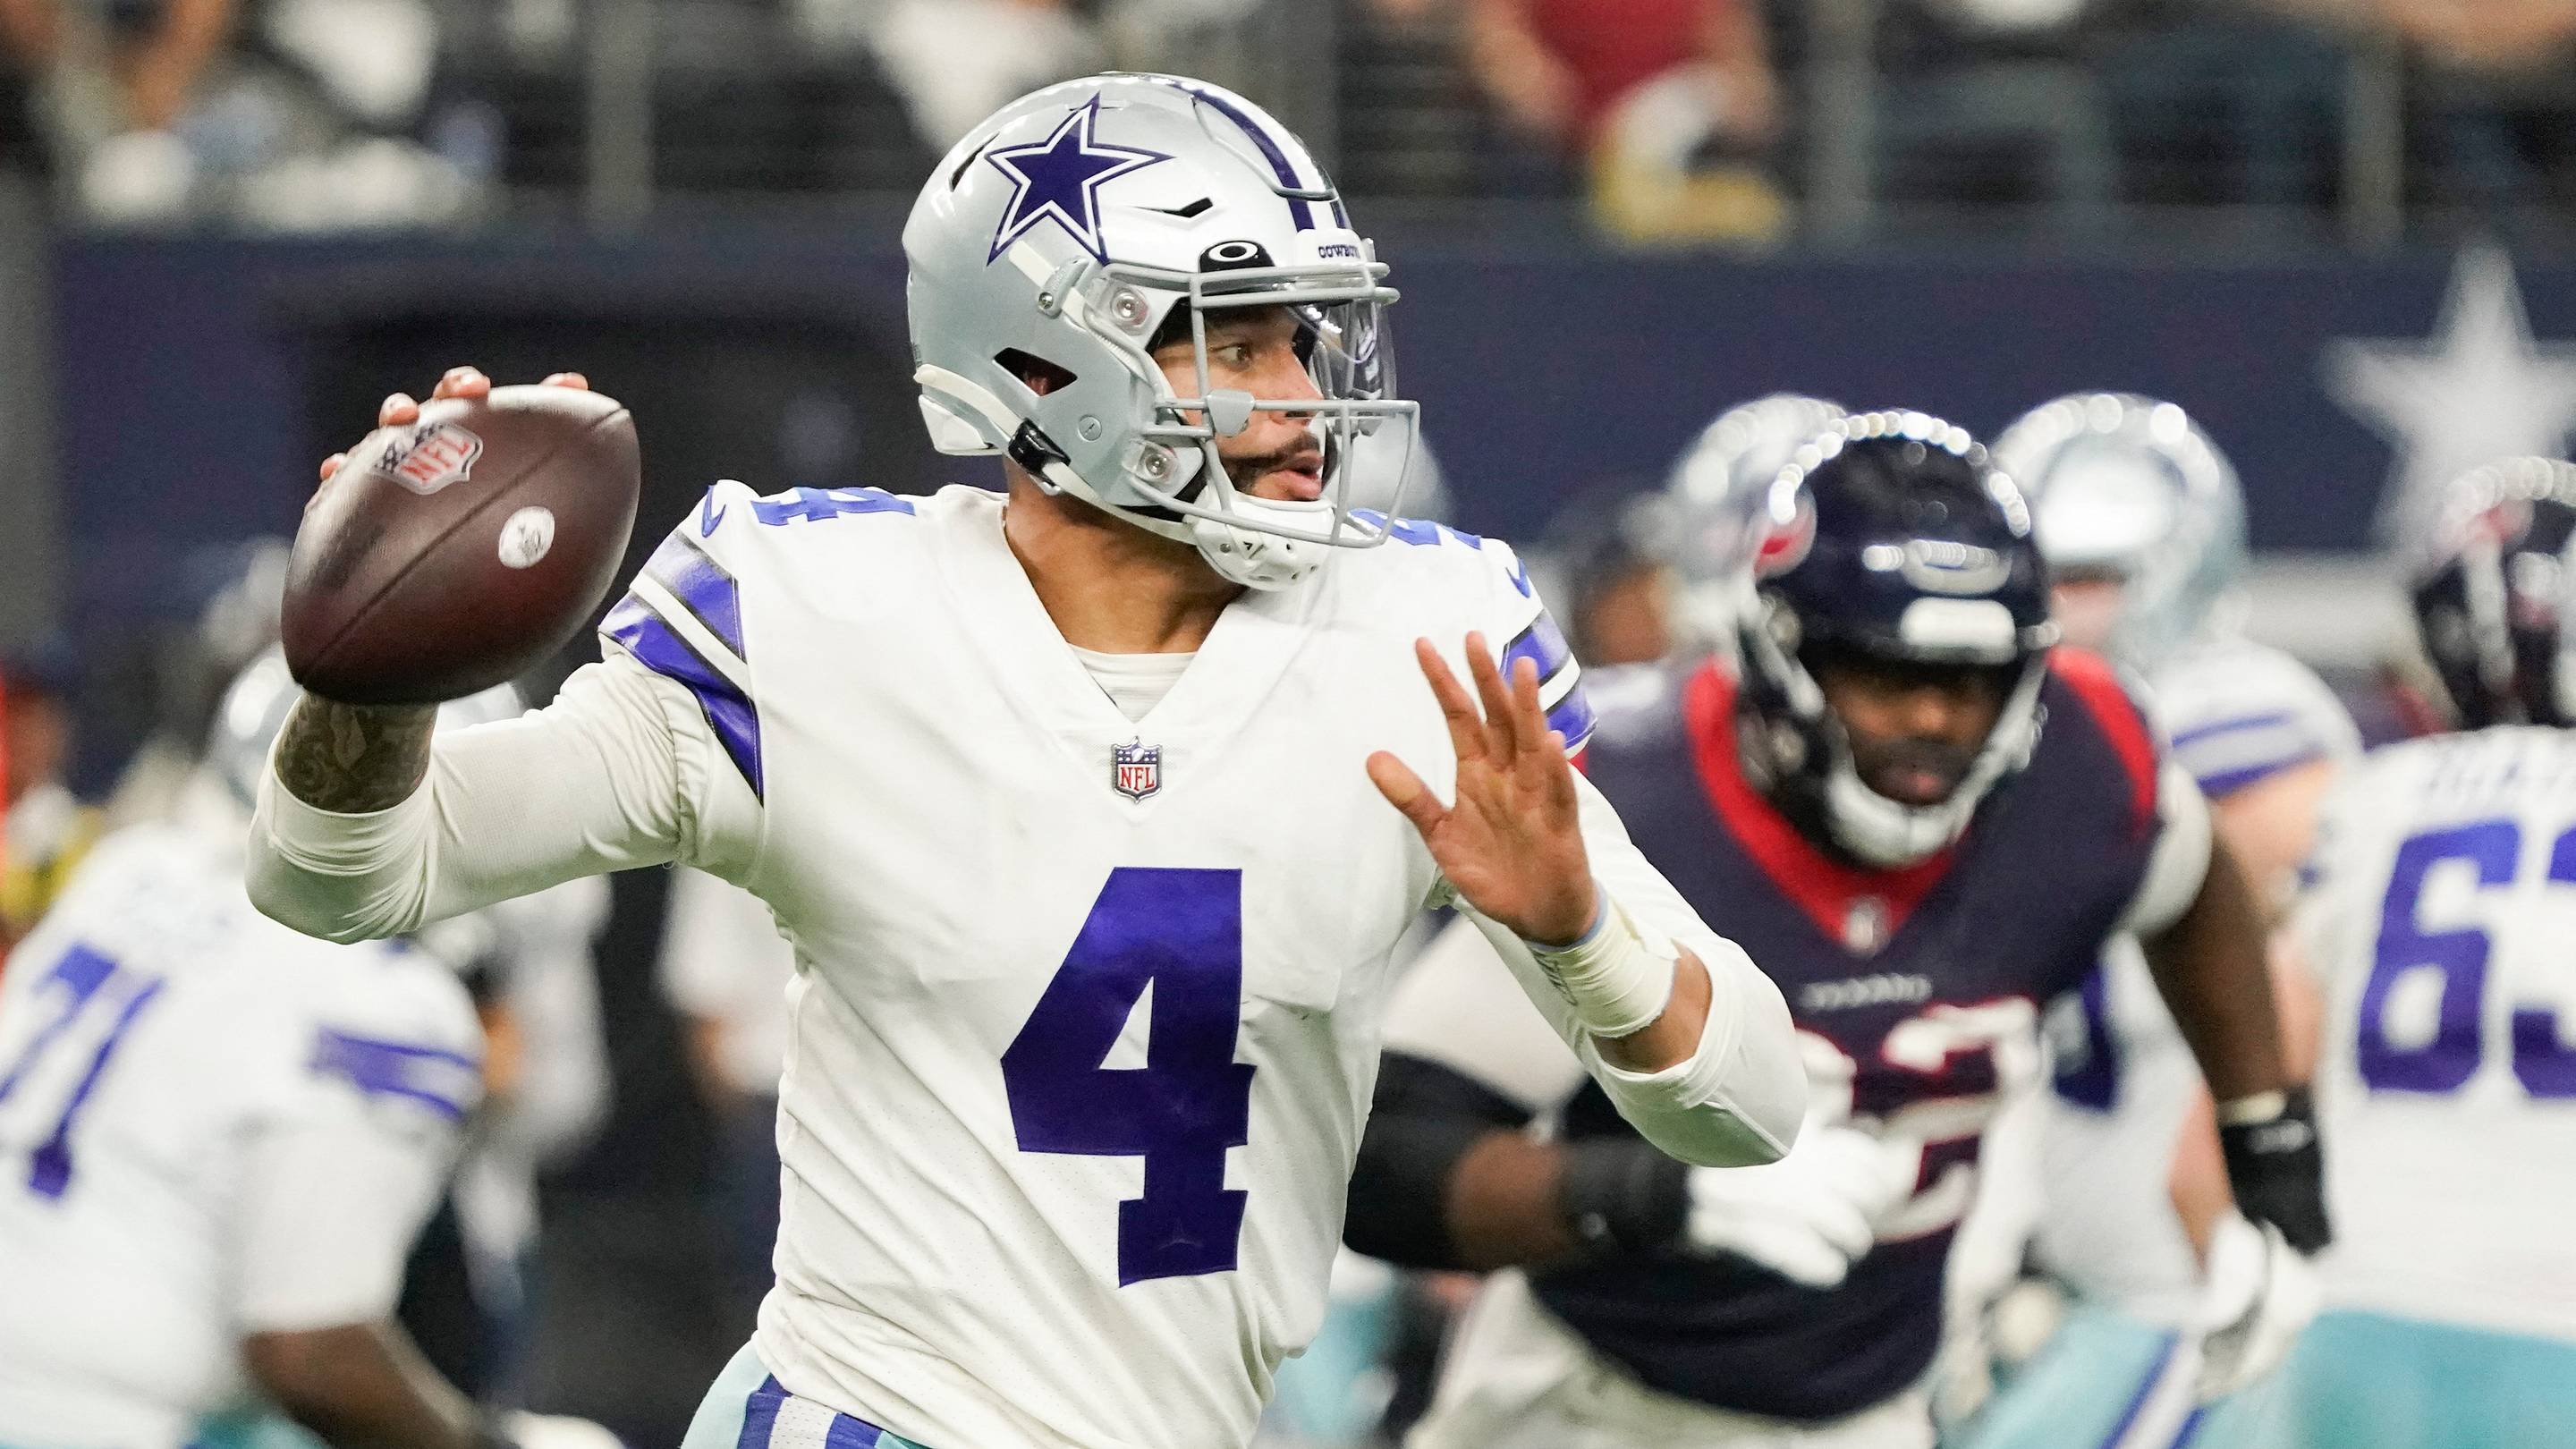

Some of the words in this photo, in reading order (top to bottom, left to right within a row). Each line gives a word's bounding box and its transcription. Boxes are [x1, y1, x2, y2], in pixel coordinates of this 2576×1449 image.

[400, 435, 470, 485] NFL
[750, 487, 916, 526] 4
[1120, 767, 1155, 791] NFL
[1001, 866, 1257, 1288] 4
